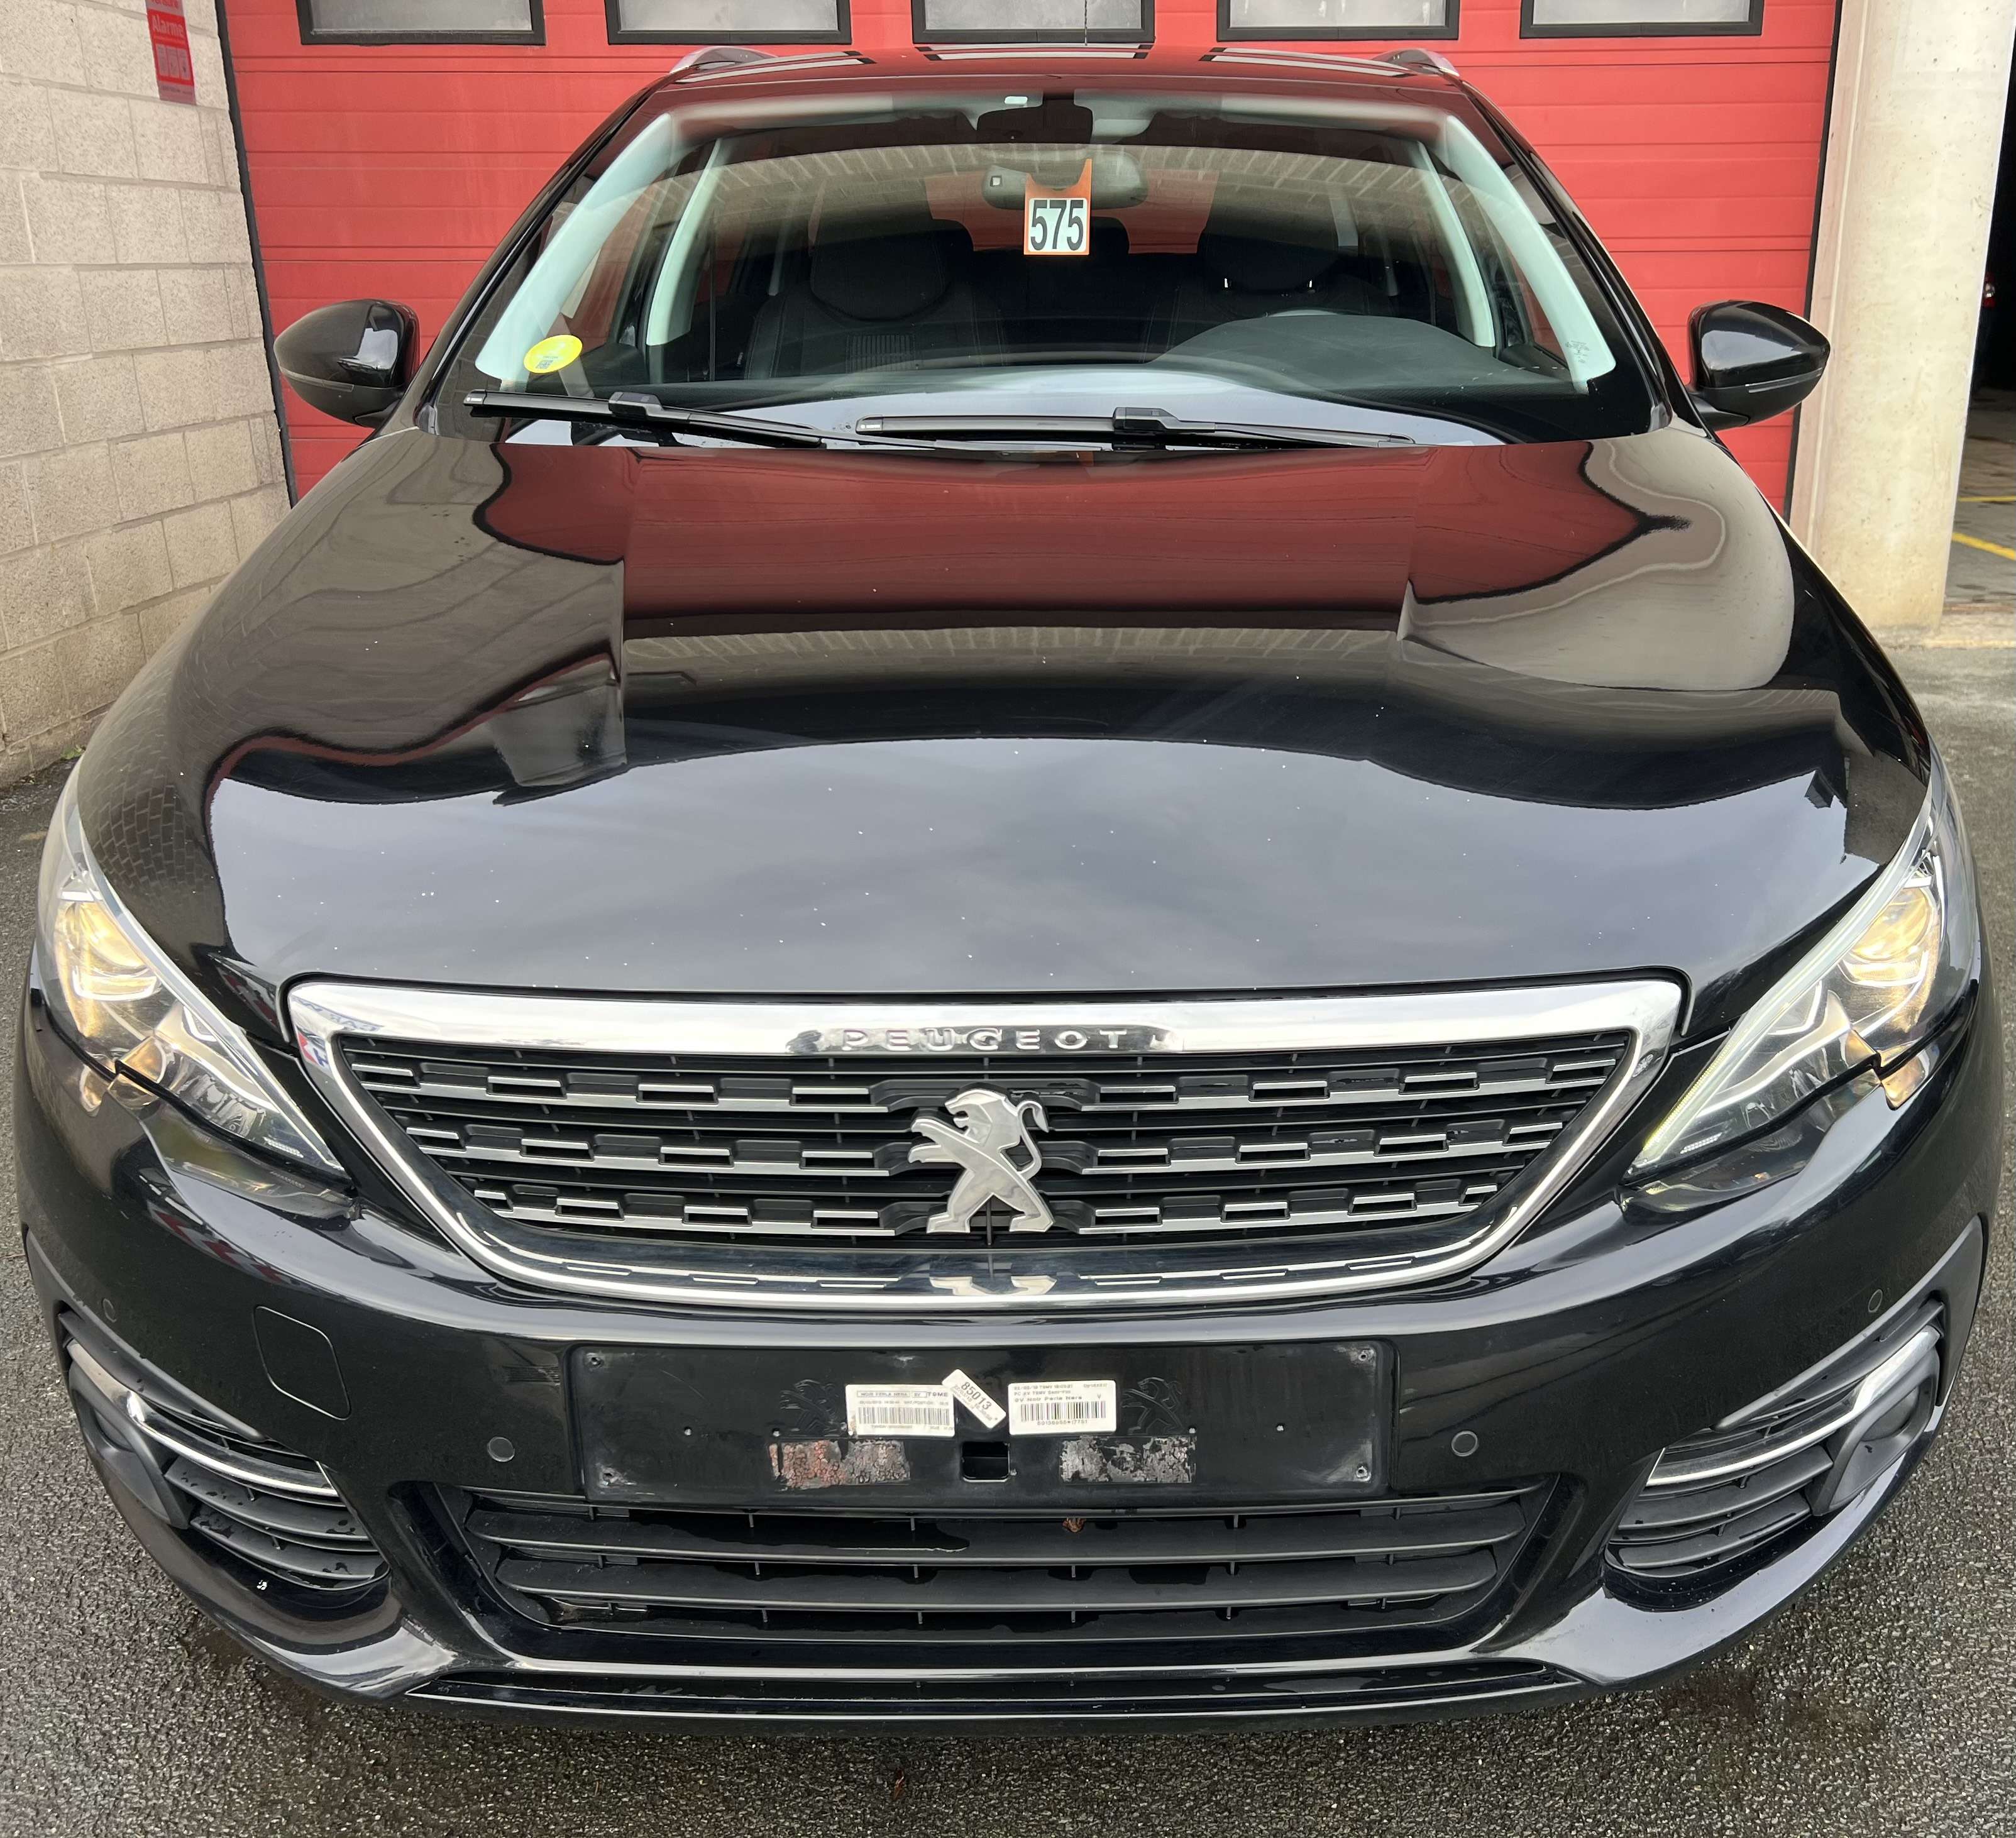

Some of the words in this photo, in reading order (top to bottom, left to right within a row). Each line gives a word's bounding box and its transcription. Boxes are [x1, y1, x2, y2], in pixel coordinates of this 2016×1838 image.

[1030, 199, 1084, 251] 575
[841, 1027, 1127, 1051] PEUGEOT
[961, 1381, 993, 1410] 85013
